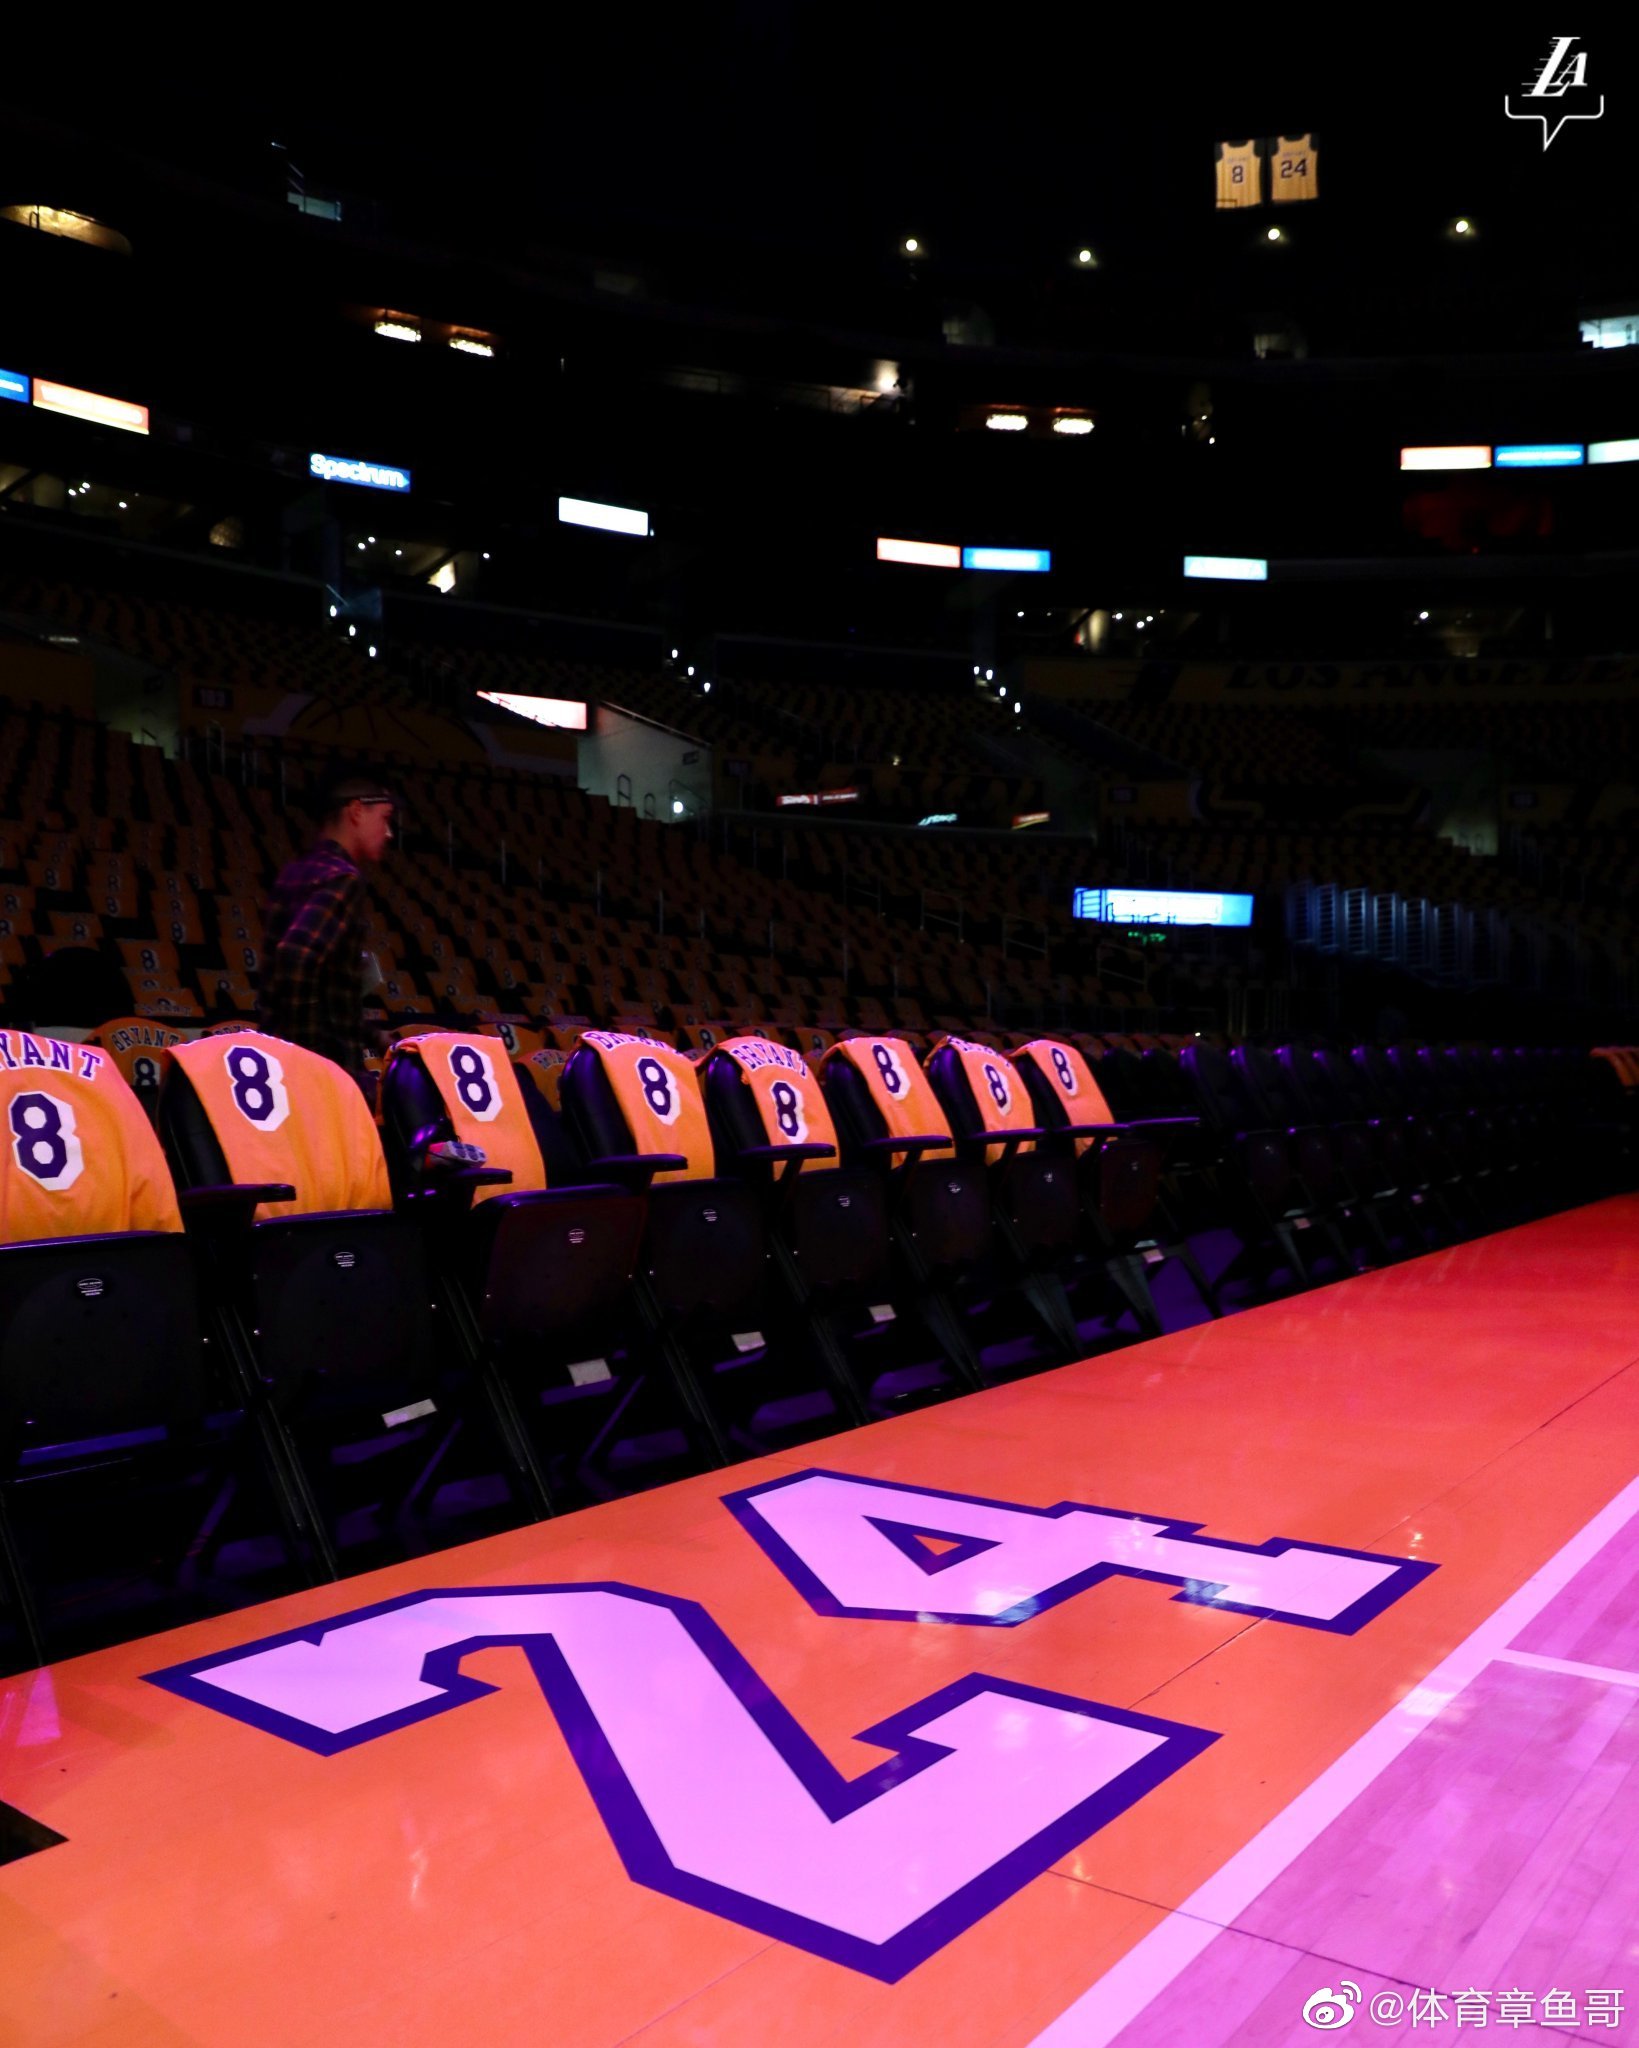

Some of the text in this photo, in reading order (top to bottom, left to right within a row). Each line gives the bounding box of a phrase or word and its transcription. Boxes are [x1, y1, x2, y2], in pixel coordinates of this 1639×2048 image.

[1232, 164, 1244, 184] 8
[1280, 158, 1307, 179] 24
[310, 453, 406, 489] Spectrum
[1353, 657, 1639, 691] ANGELE
[141, 948, 156, 971] 8
[243, 946, 256, 968] 8
[111, 1026, 181, 1052] BRYANT
[135, 1057, 158, 1090] 8
[225, 1046, 282, 1126] 8
[448, 1045, 498, 1117] 8
[636, 1057, 676, 1121] 8
[872, 1045, 906, 1097] 8
[984, 1064, 1010, 1112] 8
[1050, 1047, 1075, 1093] 8
[771, 1081, 804, 1140] 8
[9, 1092, 77, 1185] 8
[138, 1466, 1442, 1985] 24
